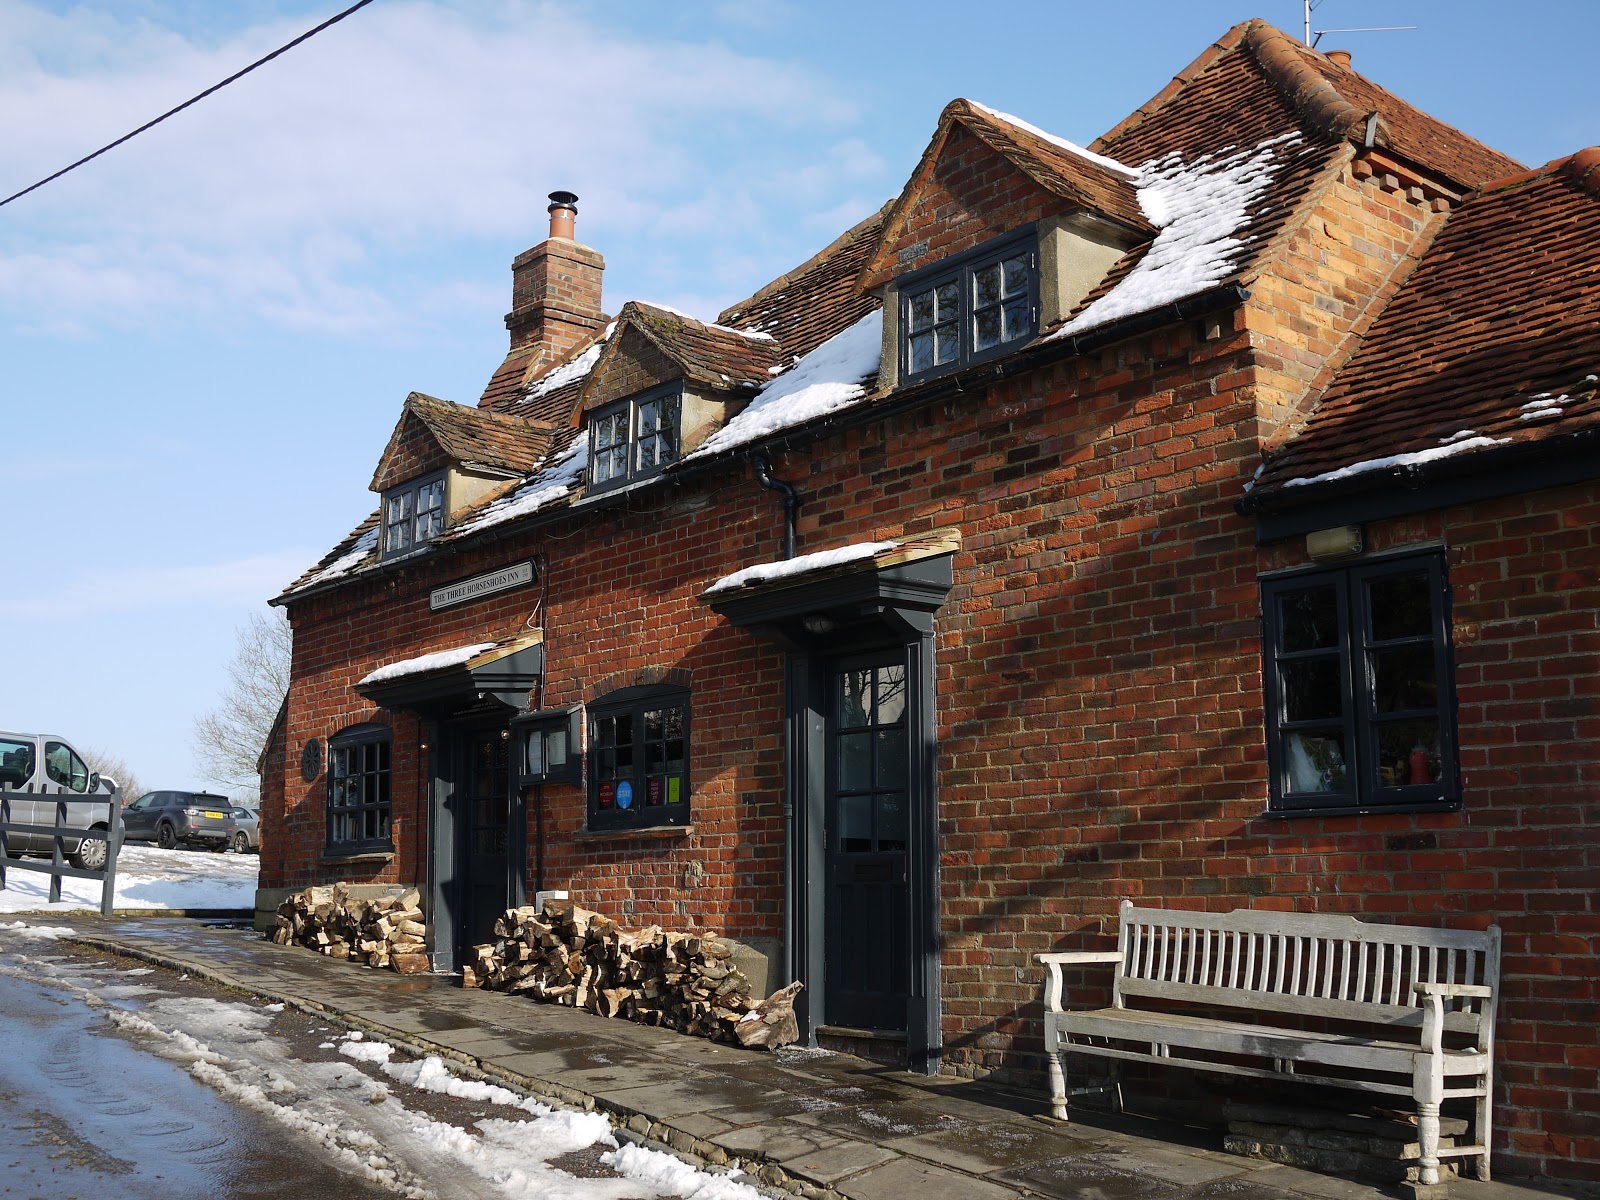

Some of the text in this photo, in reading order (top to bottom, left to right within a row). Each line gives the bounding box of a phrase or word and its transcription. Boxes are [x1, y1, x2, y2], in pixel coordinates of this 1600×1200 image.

[434, 593, 445, 603] THE
[447, 587, 466, 600] THREE
[467, 574, 506, 593] HORSESHOES
[507, 571, 519, 582] INN
[618, 790, 630, 798] STAY
